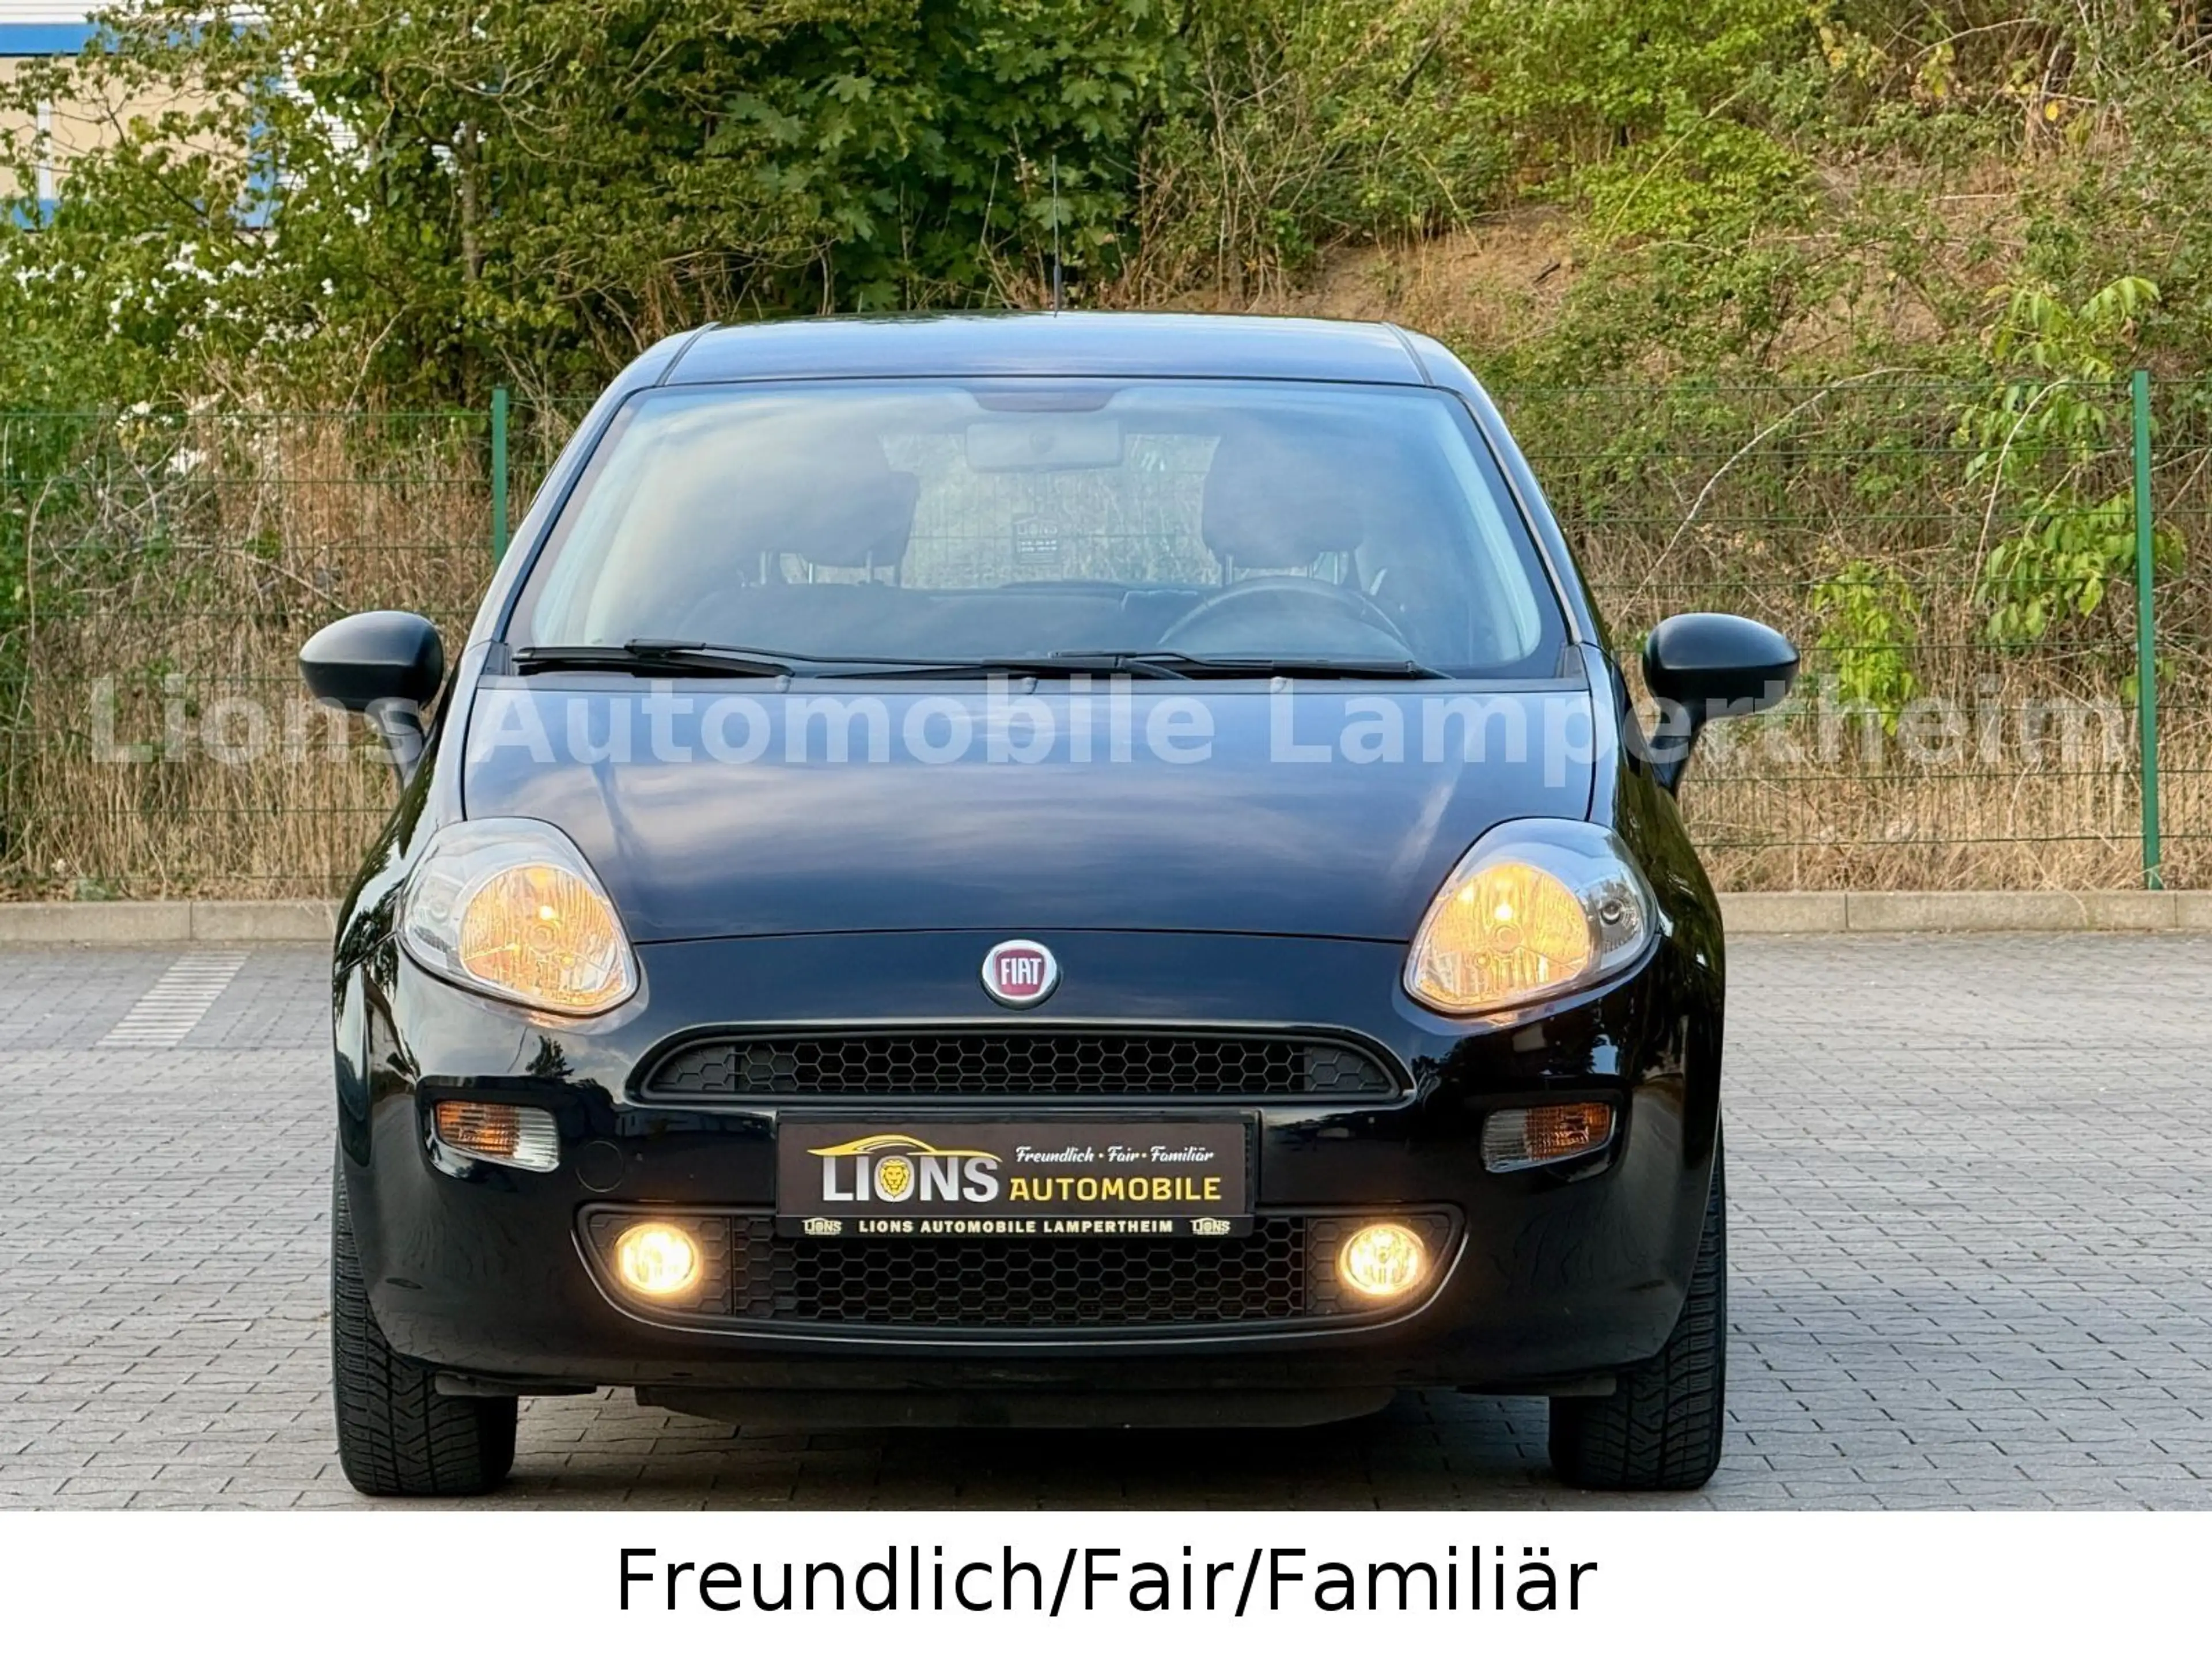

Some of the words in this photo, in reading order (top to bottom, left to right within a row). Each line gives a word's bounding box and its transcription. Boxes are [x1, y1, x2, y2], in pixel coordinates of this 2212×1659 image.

[1001, 957, 1041, 985] FIAT
[1016, 1146, 1094, 1162] Freundlich
[1107, 1145, 1141, 1162] Fair
[1150, 1145, 1214, 1162] Familiär
[823, 1154, 999, 1202] LIONS
[1009, 1177, 1222, 1202] AUTOMOBILE
[804, 1219, 842, 1232] LIONS
[859, 1219, 914, 1233] LIONS
[921, 1220, 1037, 1233] AUTOMOBILE
[1043, 1220, 1173, 1233] LAMPERTHEIM
[1191, 1221, 1231, 1232] LIONS
